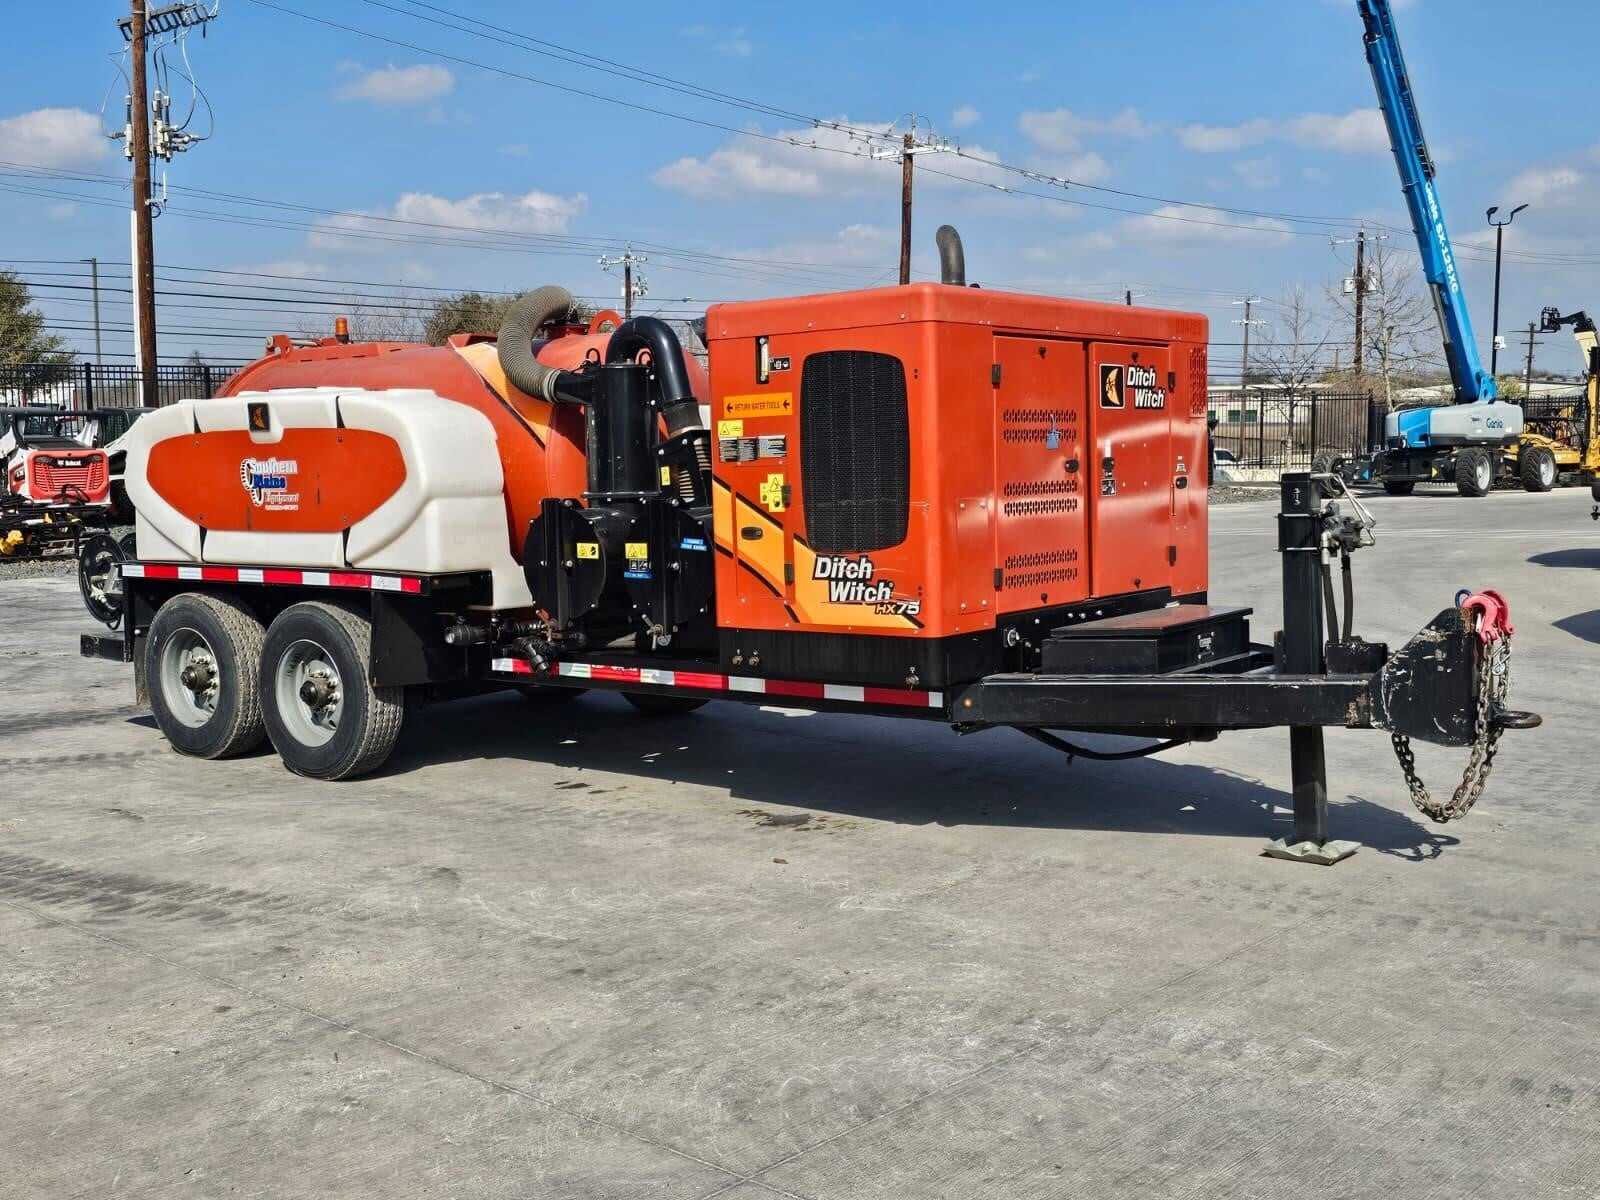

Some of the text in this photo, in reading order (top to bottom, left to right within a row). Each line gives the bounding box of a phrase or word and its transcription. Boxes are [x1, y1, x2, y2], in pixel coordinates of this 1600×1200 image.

[1126, 366, 1156, 387] Ditch
[1134, 388, 1165, 408] Witch
[814, 556, 873, 579] Ditch
[829, 580, 893, 603] Witch
[875, 601, 920, 615] HX75
